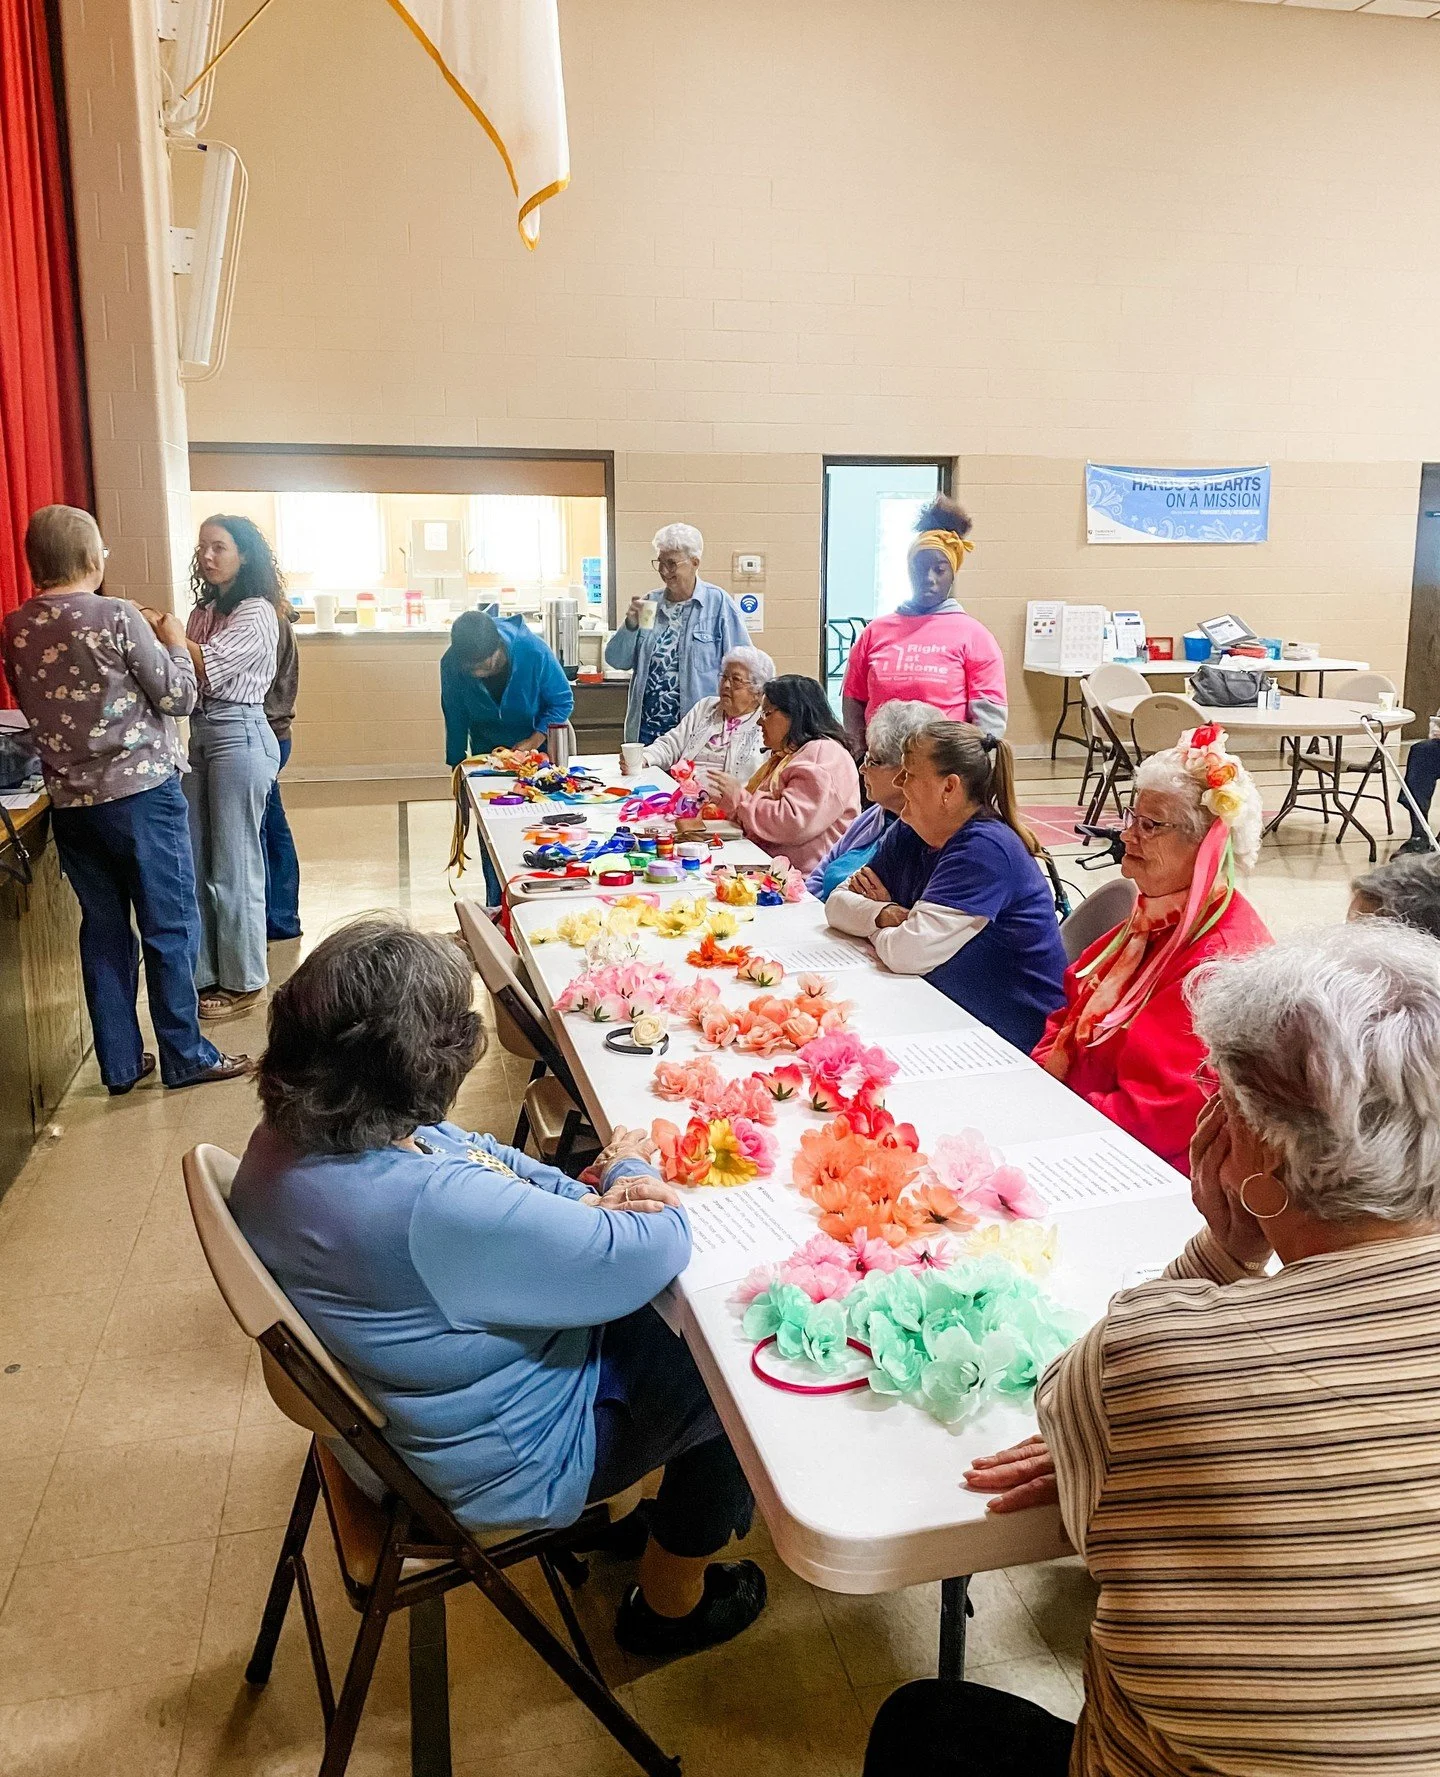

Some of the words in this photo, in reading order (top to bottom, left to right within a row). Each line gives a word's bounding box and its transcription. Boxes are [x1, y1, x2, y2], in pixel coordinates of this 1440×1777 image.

[1166, 493, 1186, 508] ON
[1190, 493, 1198, 508] A
[1203, 493, 1261, 508] MISSION
[907, 643, 947, 655] Right
[905, 653, 920, 662] at
[903, 664, 949, 674] Home
